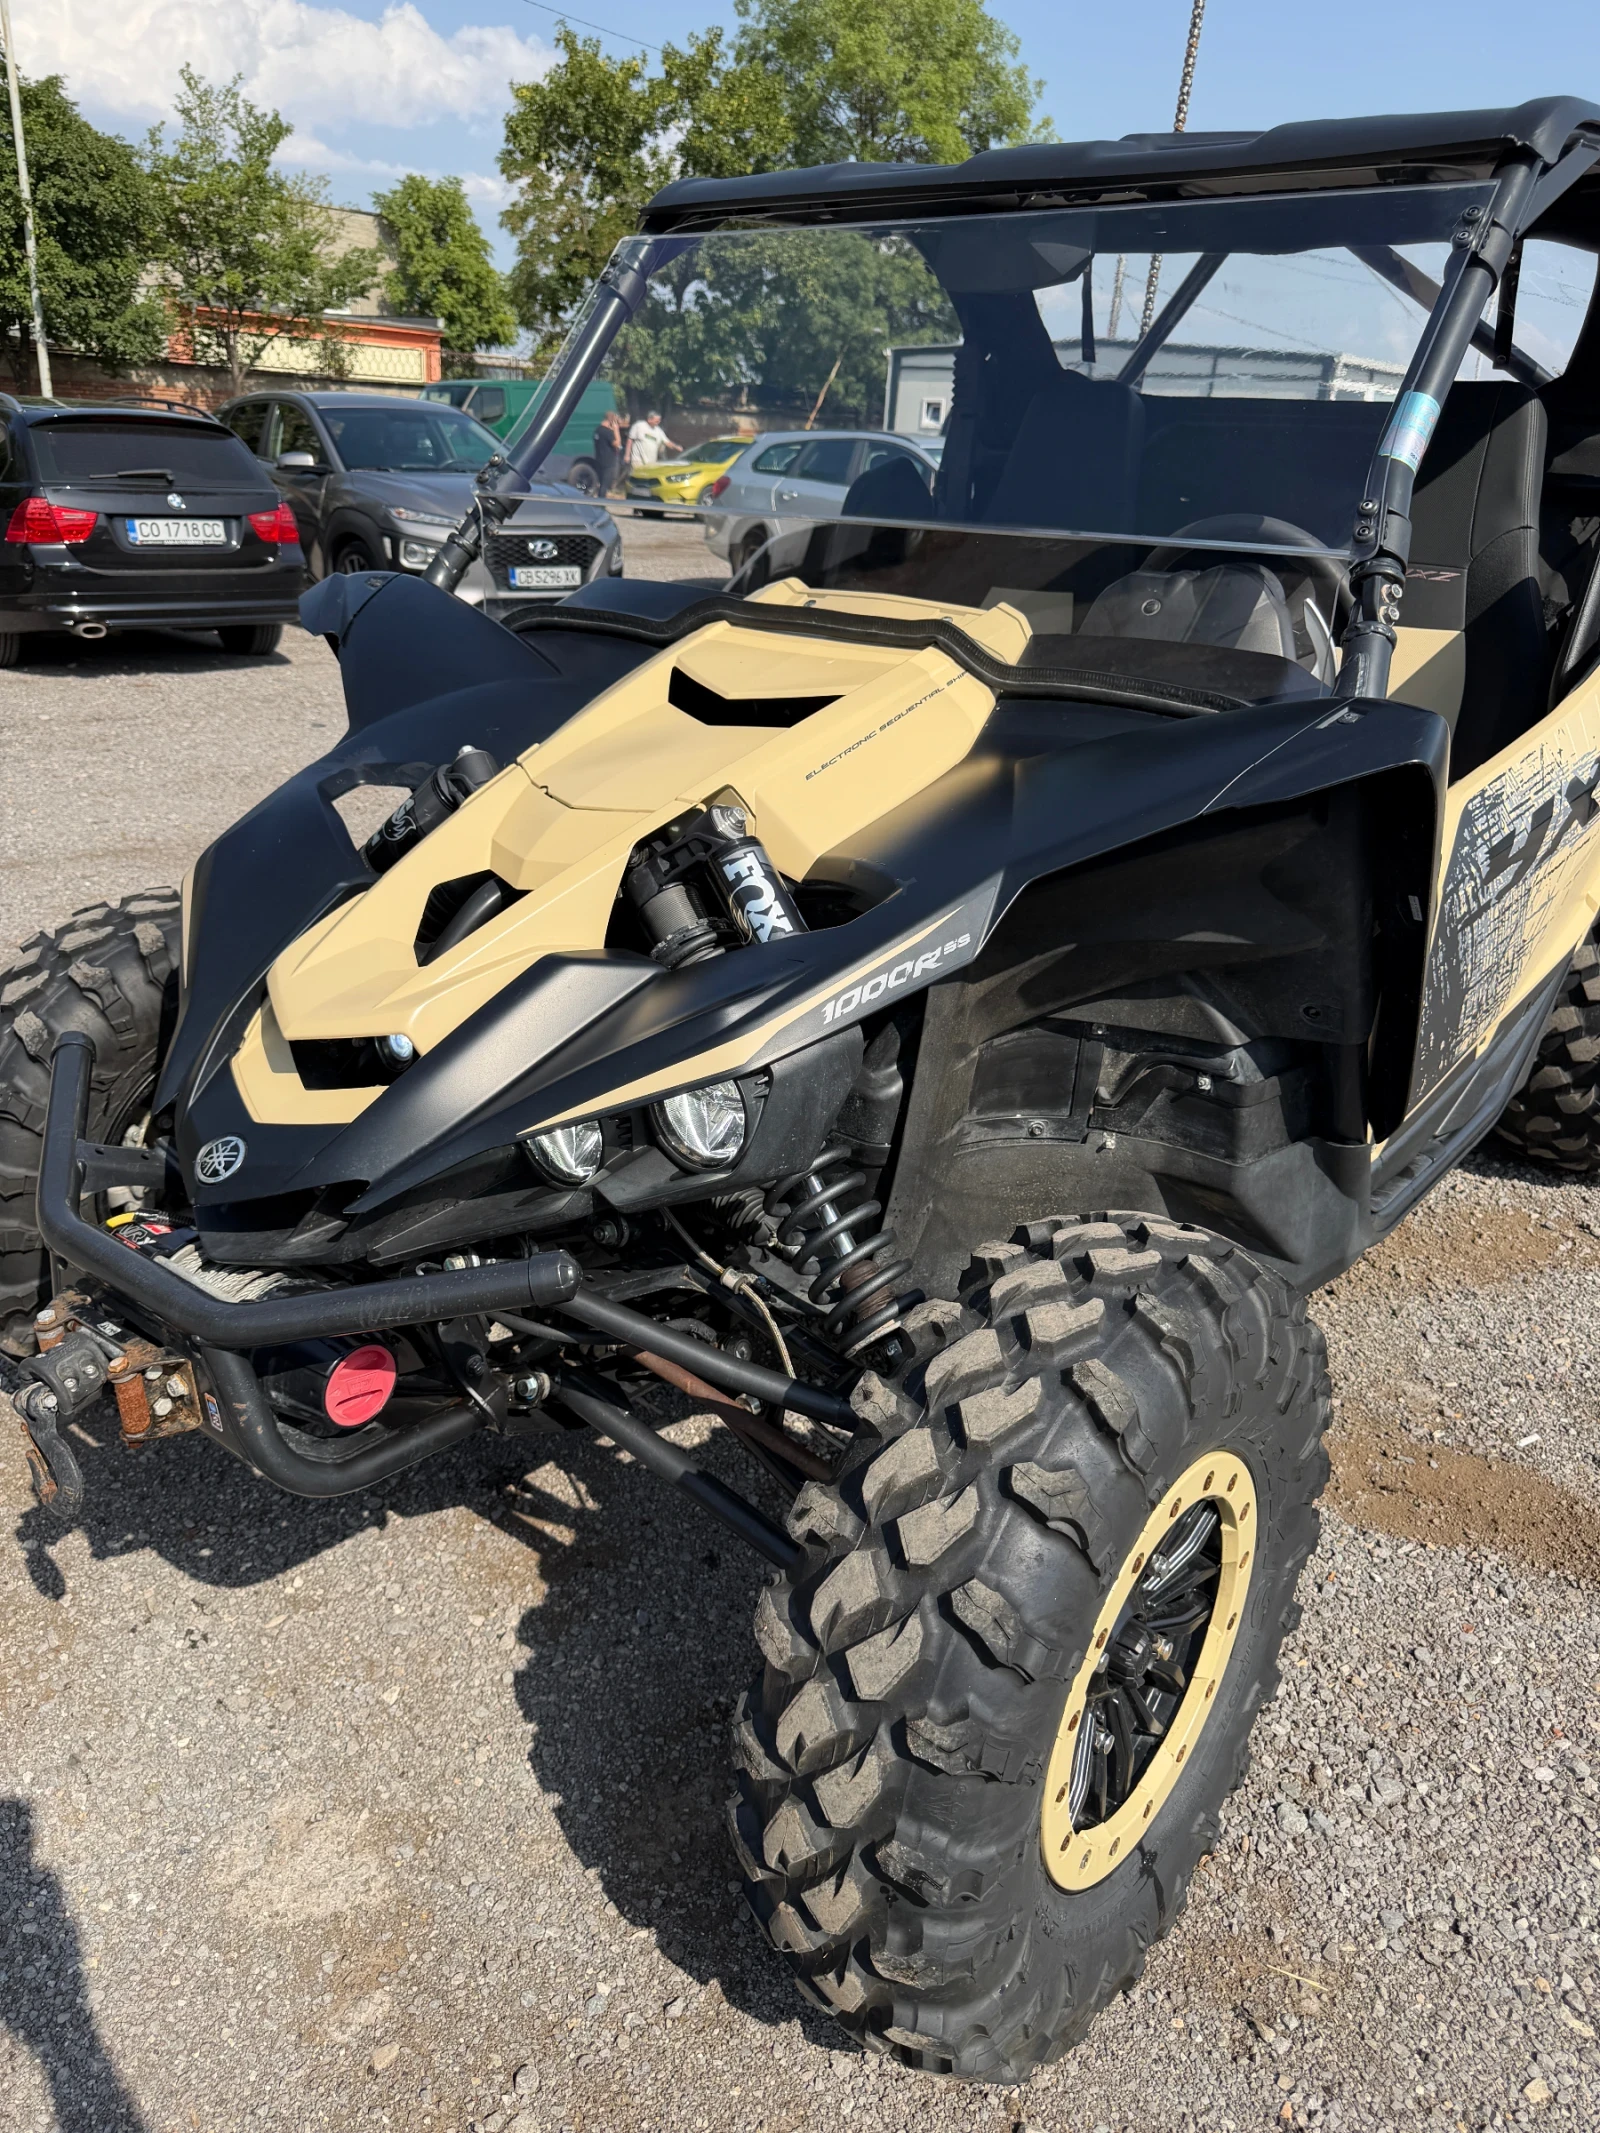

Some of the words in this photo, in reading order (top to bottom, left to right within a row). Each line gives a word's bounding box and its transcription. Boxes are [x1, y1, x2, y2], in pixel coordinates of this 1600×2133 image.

[138, 521, 160, 538] CO
[164, 521, 200, 538] 1718
[202, 522, 222, 538] CC
[518, 570, 533, 585] CB
[805, 730, 877, 781] ELECTRONIC
[879, 687, 945, 732] SEQUENTIAL
[722, 851, 794, 945] FOX
[820, 946, 943, 1025] 1000R
